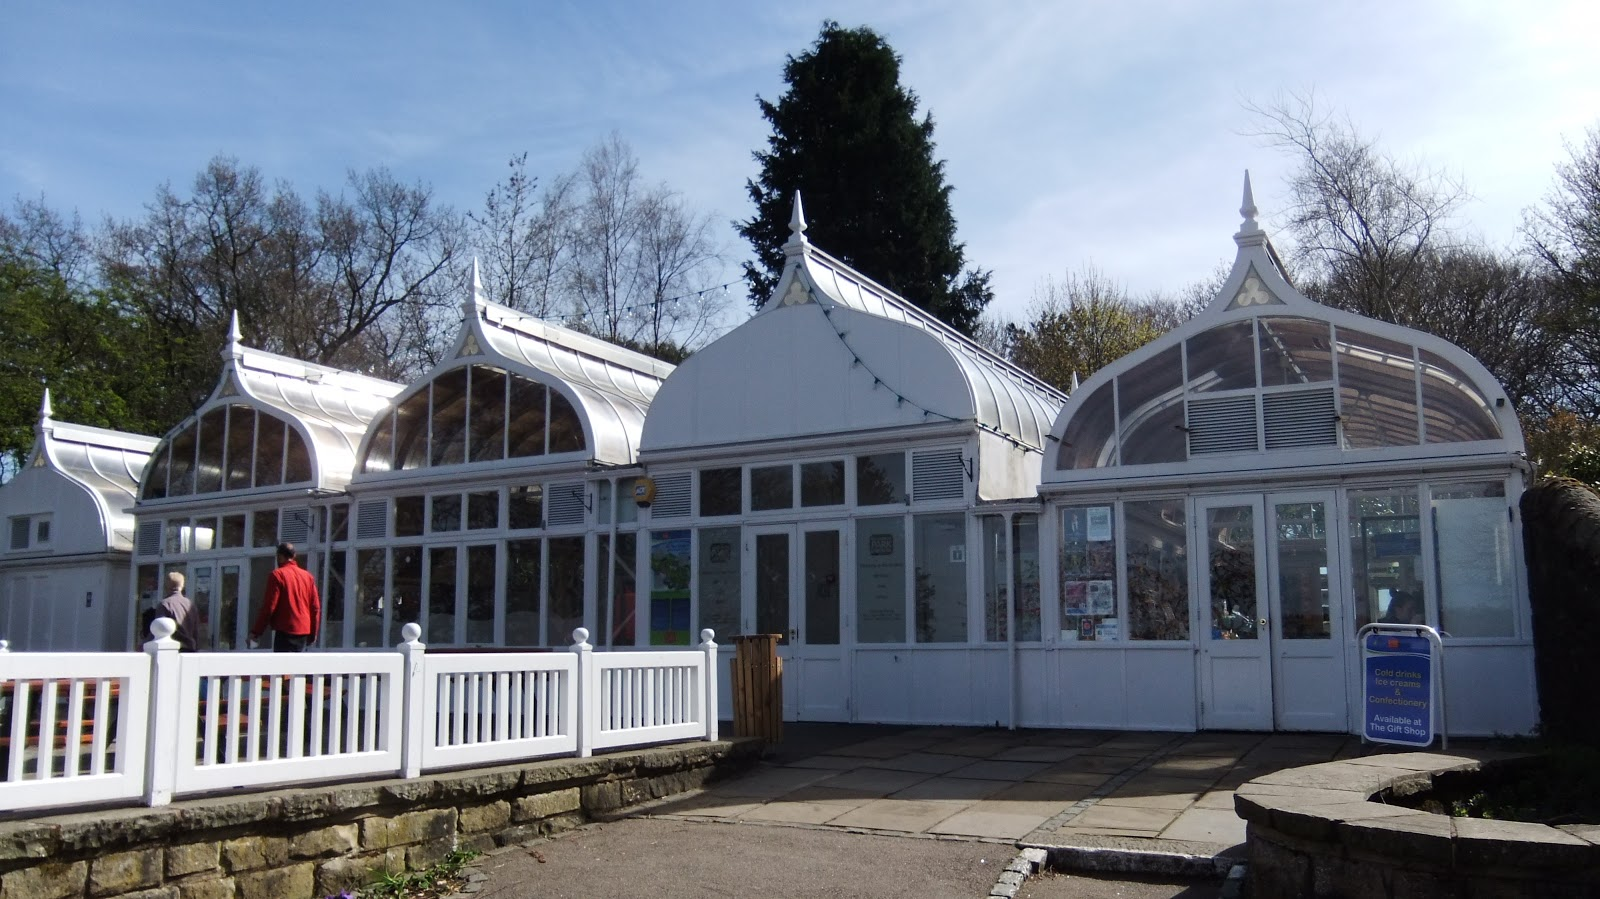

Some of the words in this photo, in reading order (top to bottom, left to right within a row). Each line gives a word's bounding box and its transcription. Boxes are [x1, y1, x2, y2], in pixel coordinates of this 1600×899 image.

[1375, 669, 1393, 677] Cold
[1395, 670, 1422, 678] drinks
[1369, 696, 1426, 709] Confectionery
[1374, 714, 1412, 724] Available
[1370, 722, 1385, 732] The
[1387, 724, 1402, 734] Gift
[1404, 726, 1426, 737] Shop
